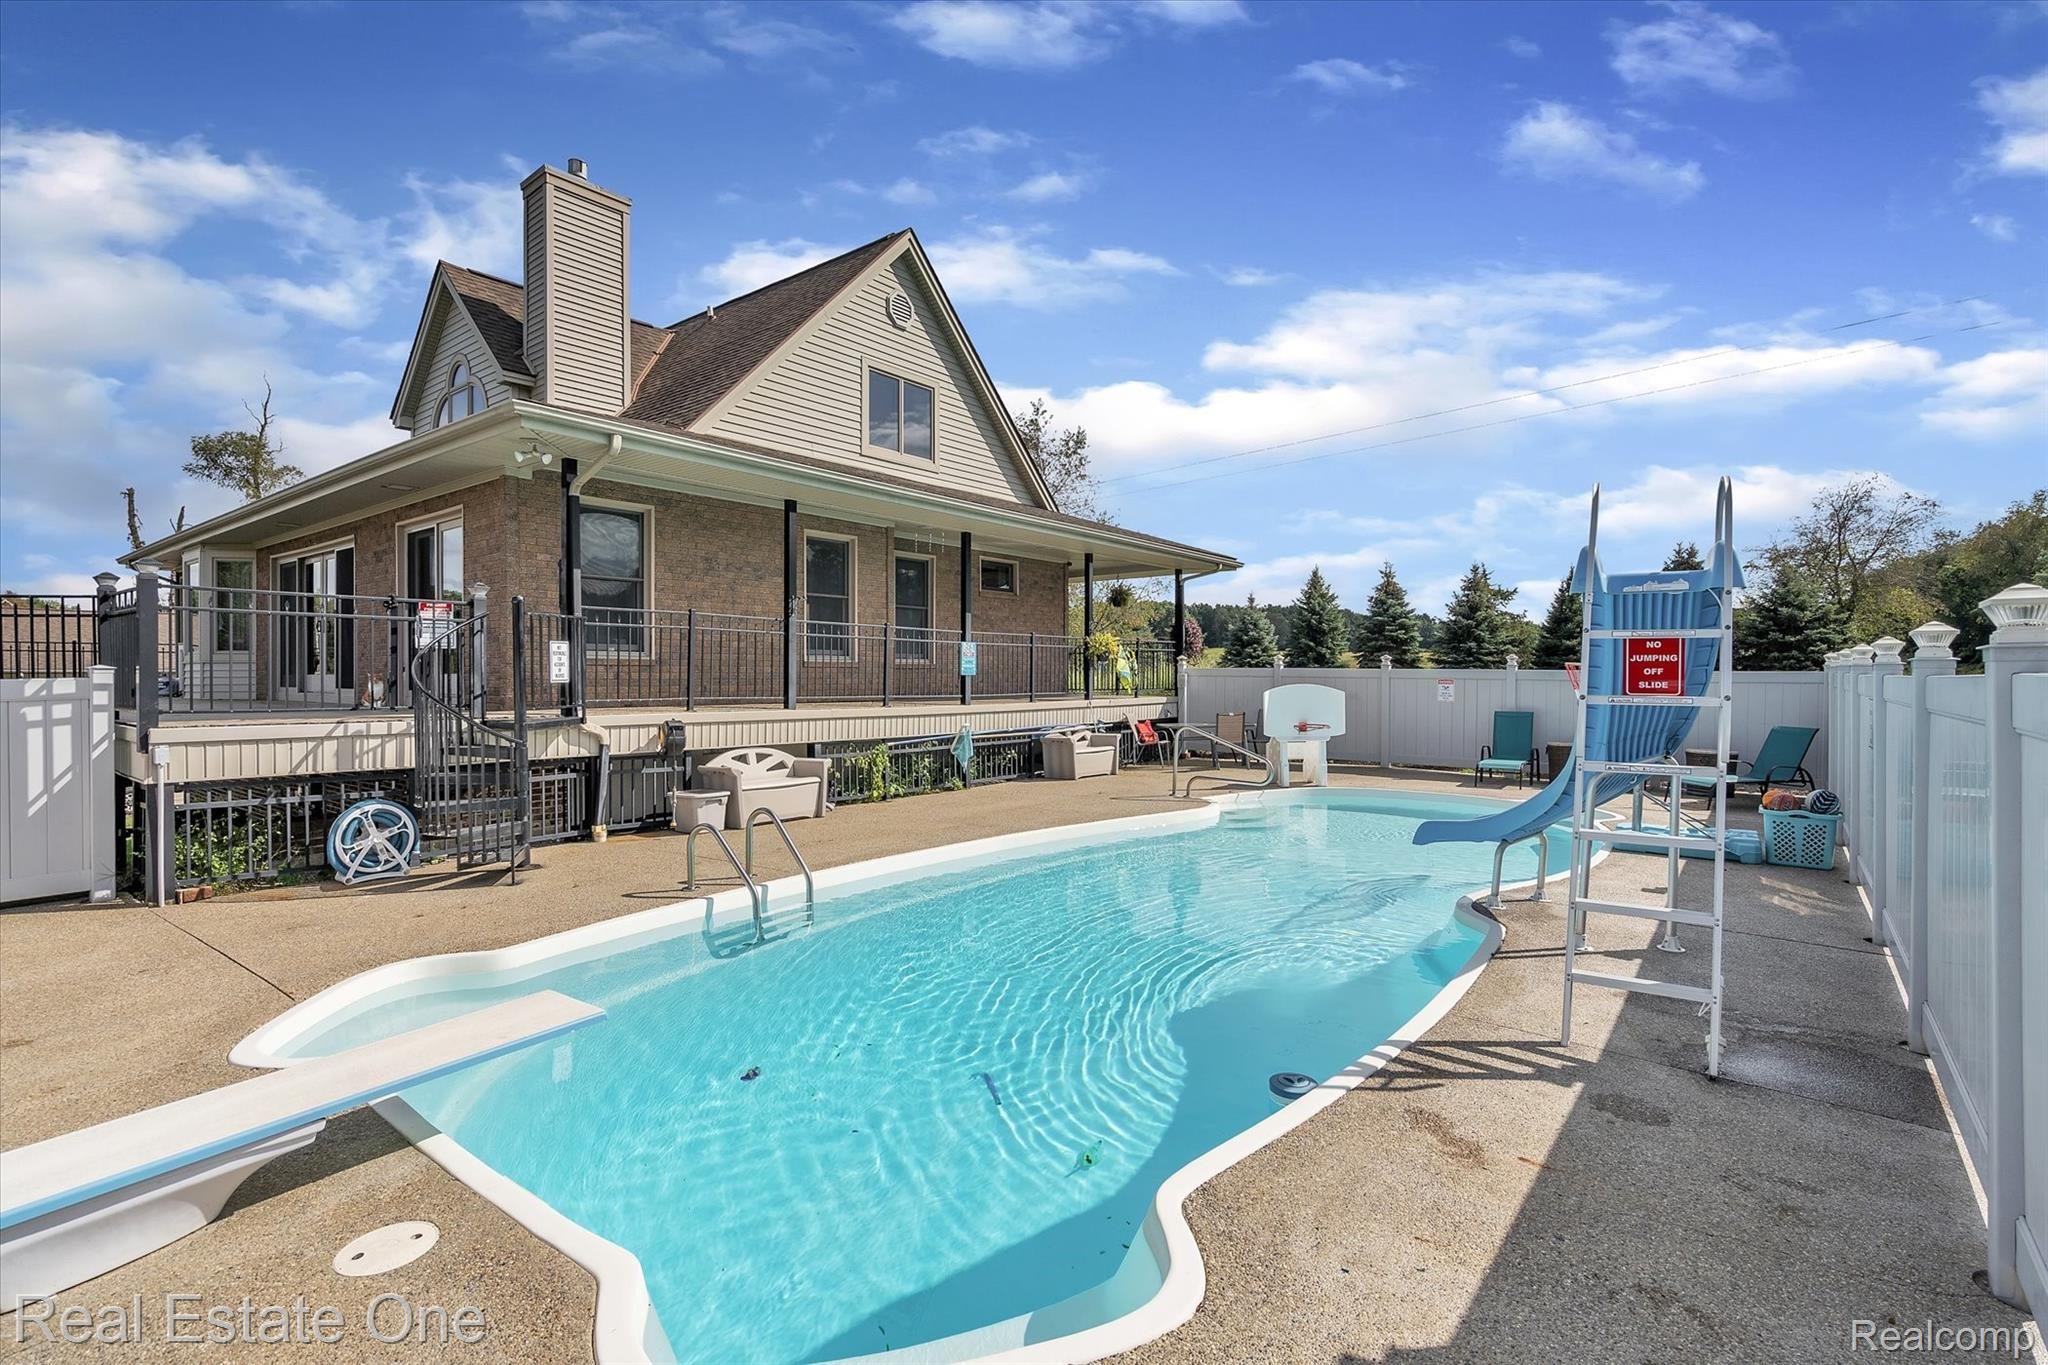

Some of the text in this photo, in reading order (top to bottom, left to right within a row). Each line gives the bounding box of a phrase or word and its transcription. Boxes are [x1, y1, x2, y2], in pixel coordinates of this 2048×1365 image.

[1646, 641, 1662, 649] NO
[1630, 654, 1678, 662] JUMPING
[1643, 668, 1664, 676] OFF
[1638, 681, 1669, 689] SLIDE
